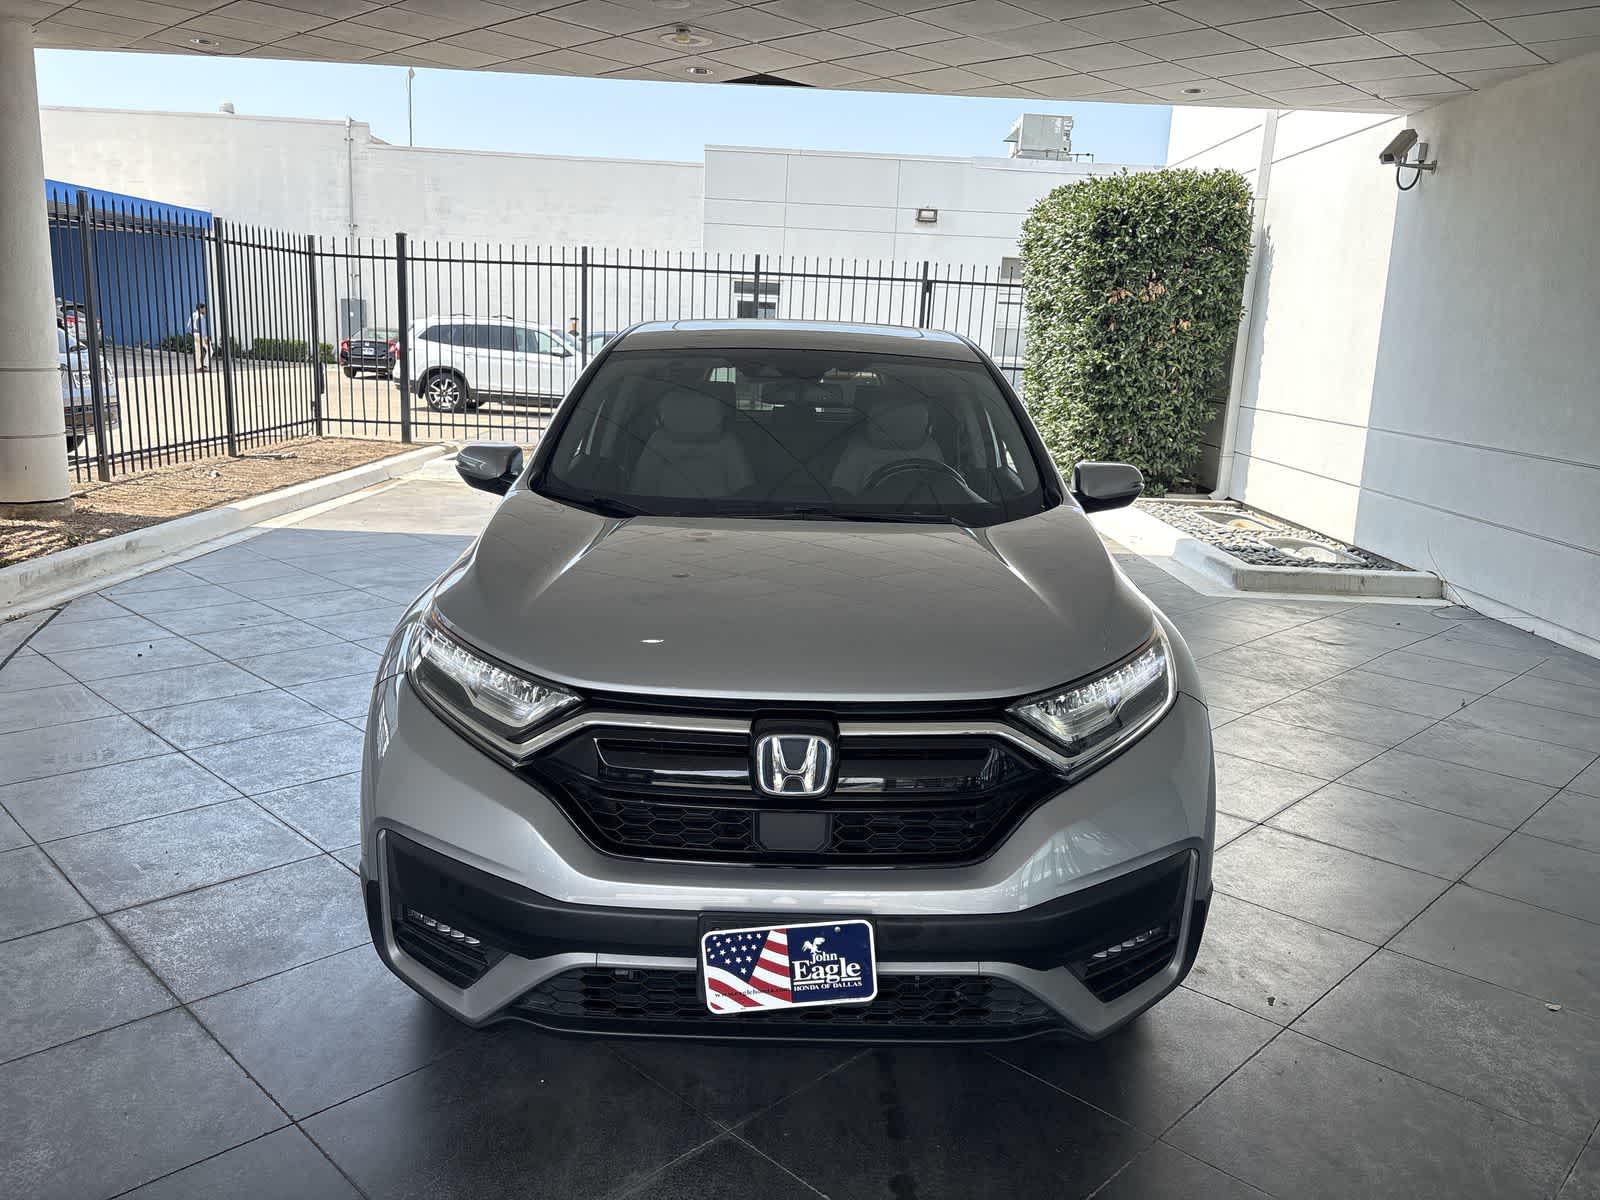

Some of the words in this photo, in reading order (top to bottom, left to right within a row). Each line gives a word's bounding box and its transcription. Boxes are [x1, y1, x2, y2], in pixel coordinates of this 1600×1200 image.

[810, 951, 838, 965] John
[792, 957, 862, 984] Eagle
[794, 984, 820, 992] HONDA
[833, 981, 863, 989] DALLAS
